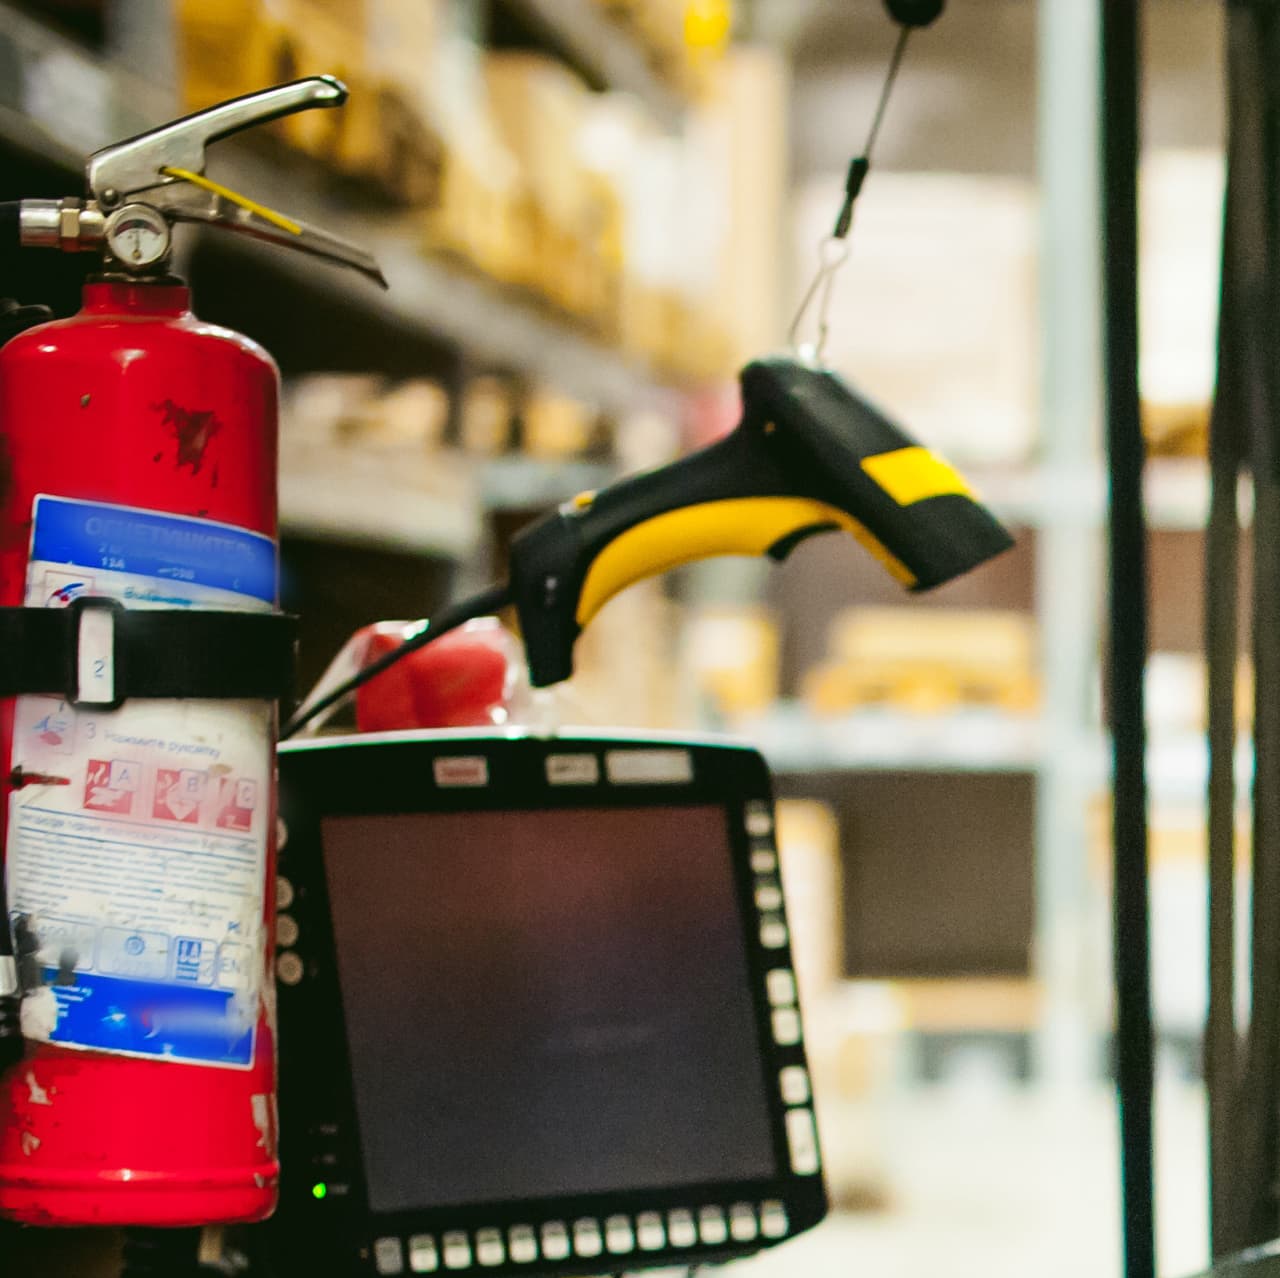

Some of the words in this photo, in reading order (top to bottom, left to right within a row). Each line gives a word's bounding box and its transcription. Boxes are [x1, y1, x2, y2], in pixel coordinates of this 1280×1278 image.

[93, 659, 105, 678] 2
[86, 721, 97, 740] 3
[117, 768, 130, 783] A
[187, 777, 199, 793] B
